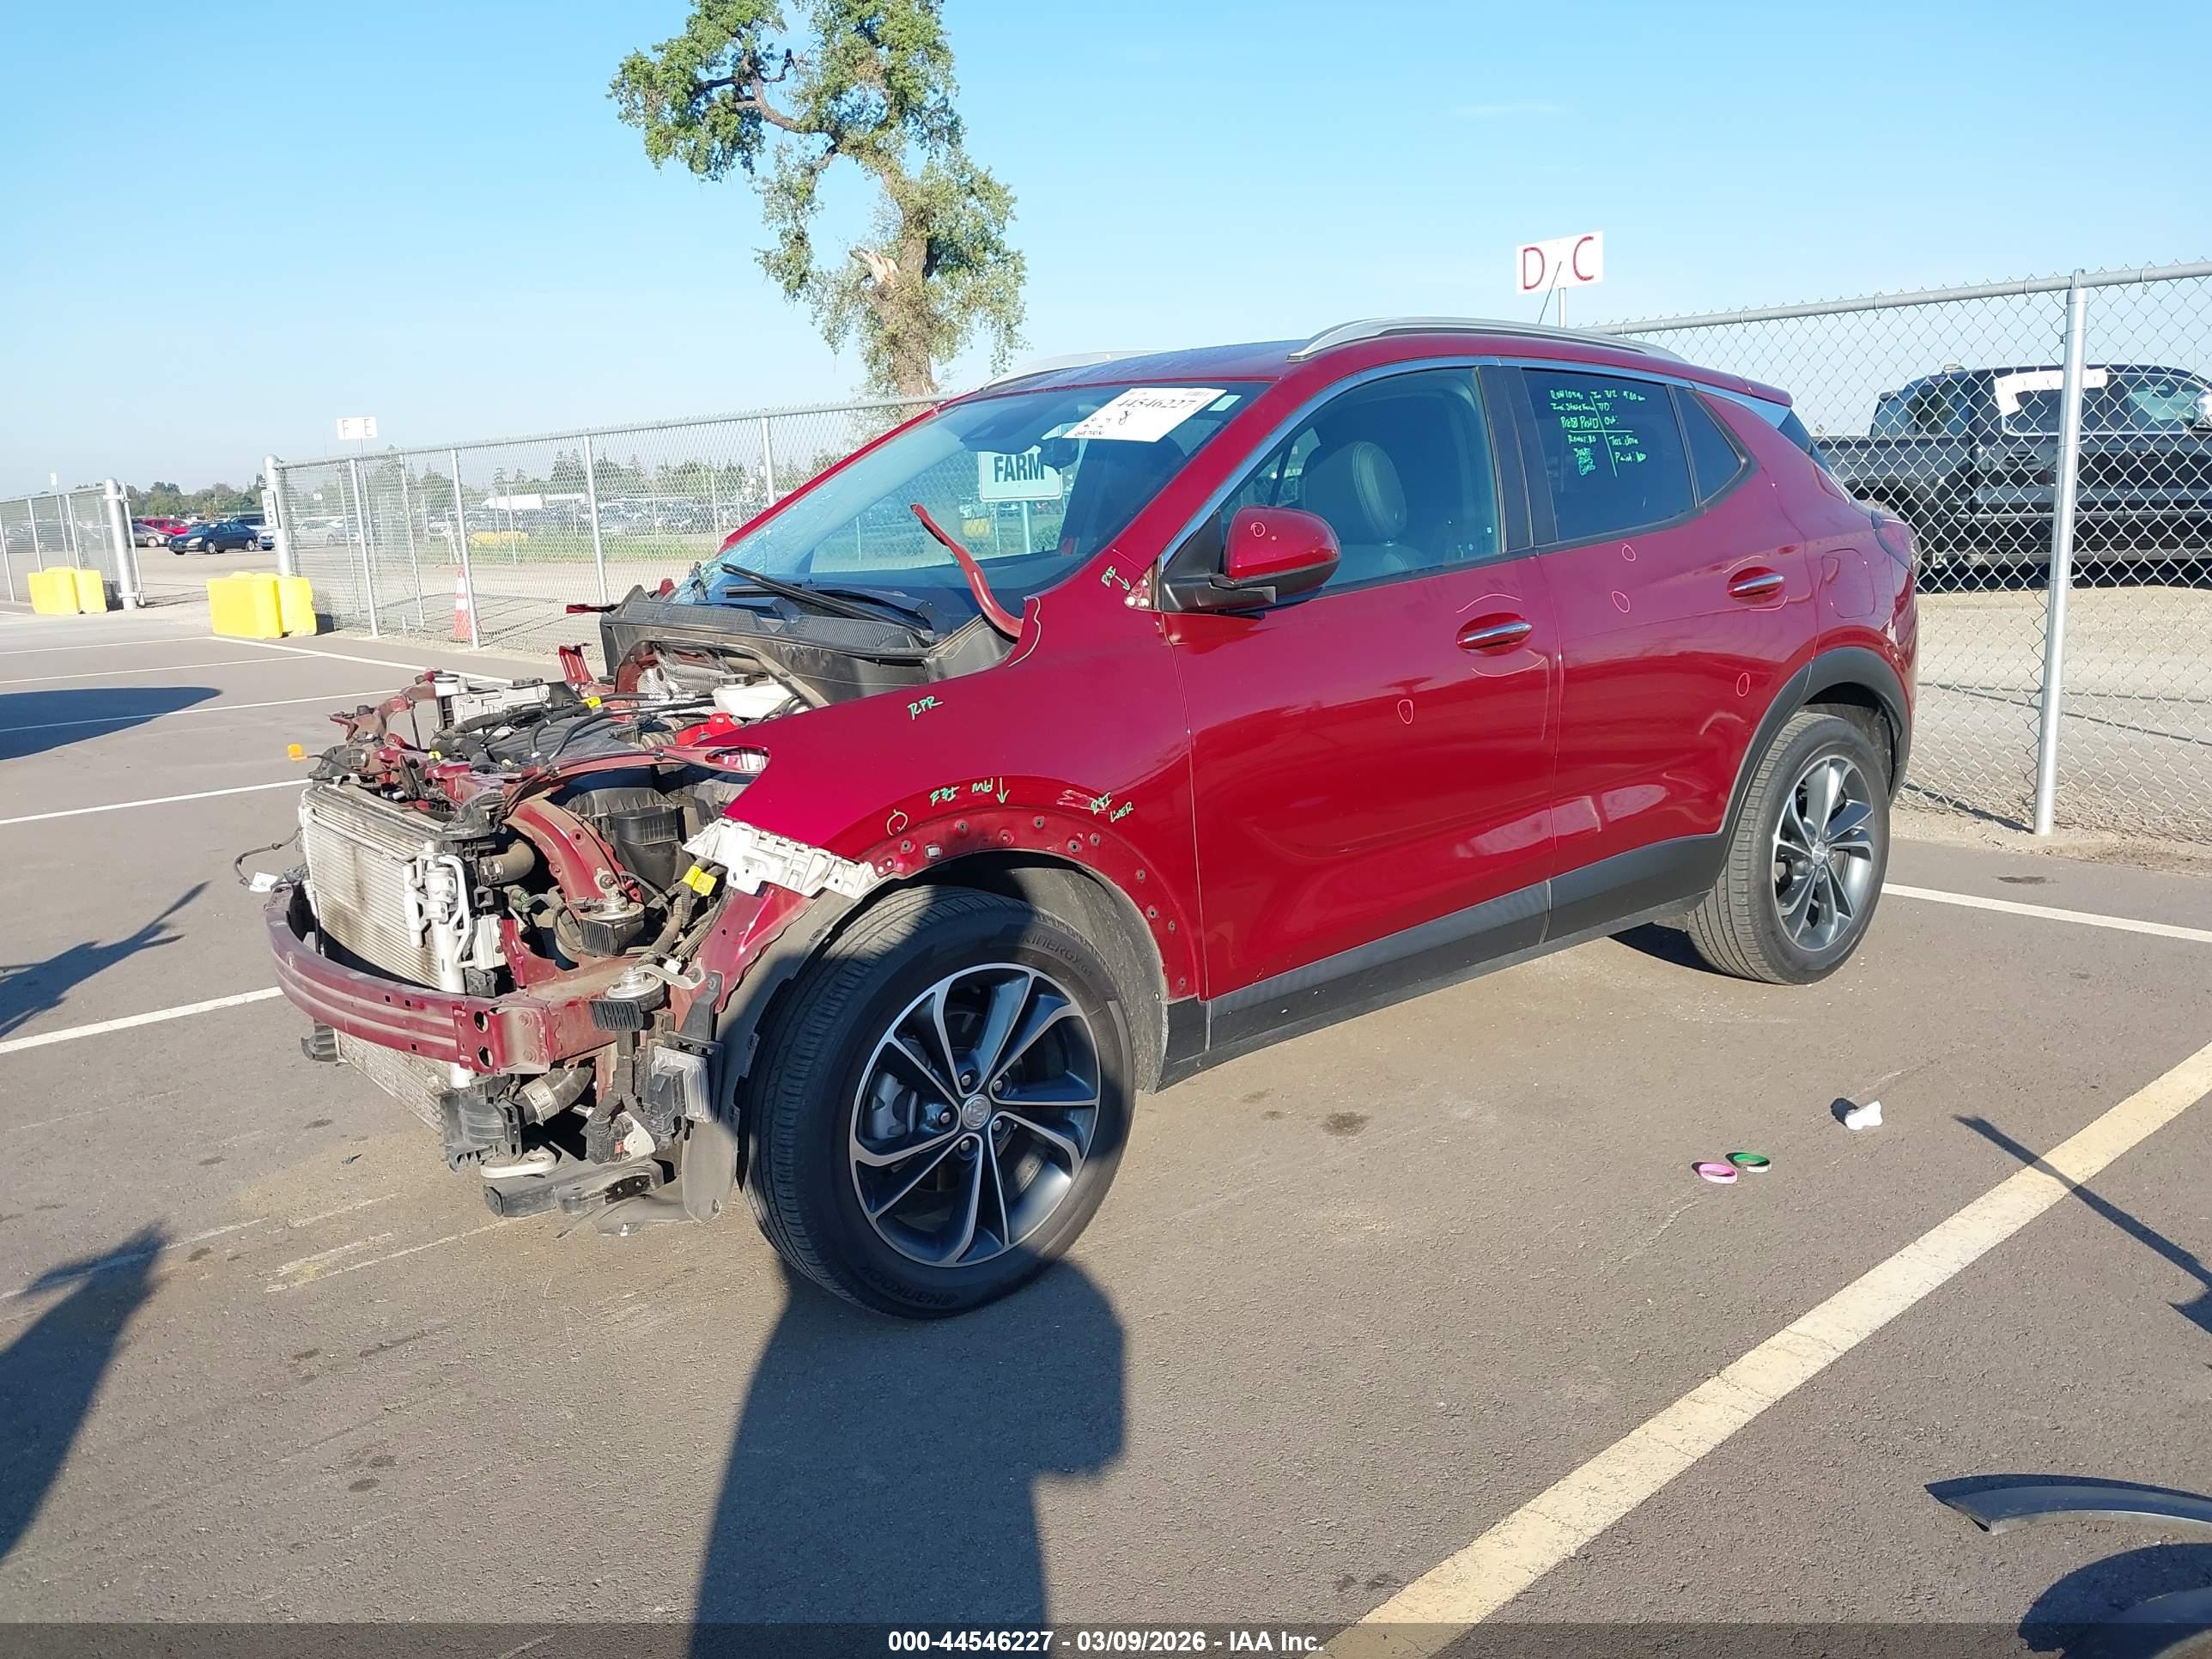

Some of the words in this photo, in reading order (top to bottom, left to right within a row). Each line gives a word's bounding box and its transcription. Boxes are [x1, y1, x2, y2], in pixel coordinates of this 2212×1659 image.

[1522, 246, 1545, 290] D
[1572, 235, 1595, 281] C
[994, 453, 1046, 483] FARM
[907, 696, 945, 720] RPR
